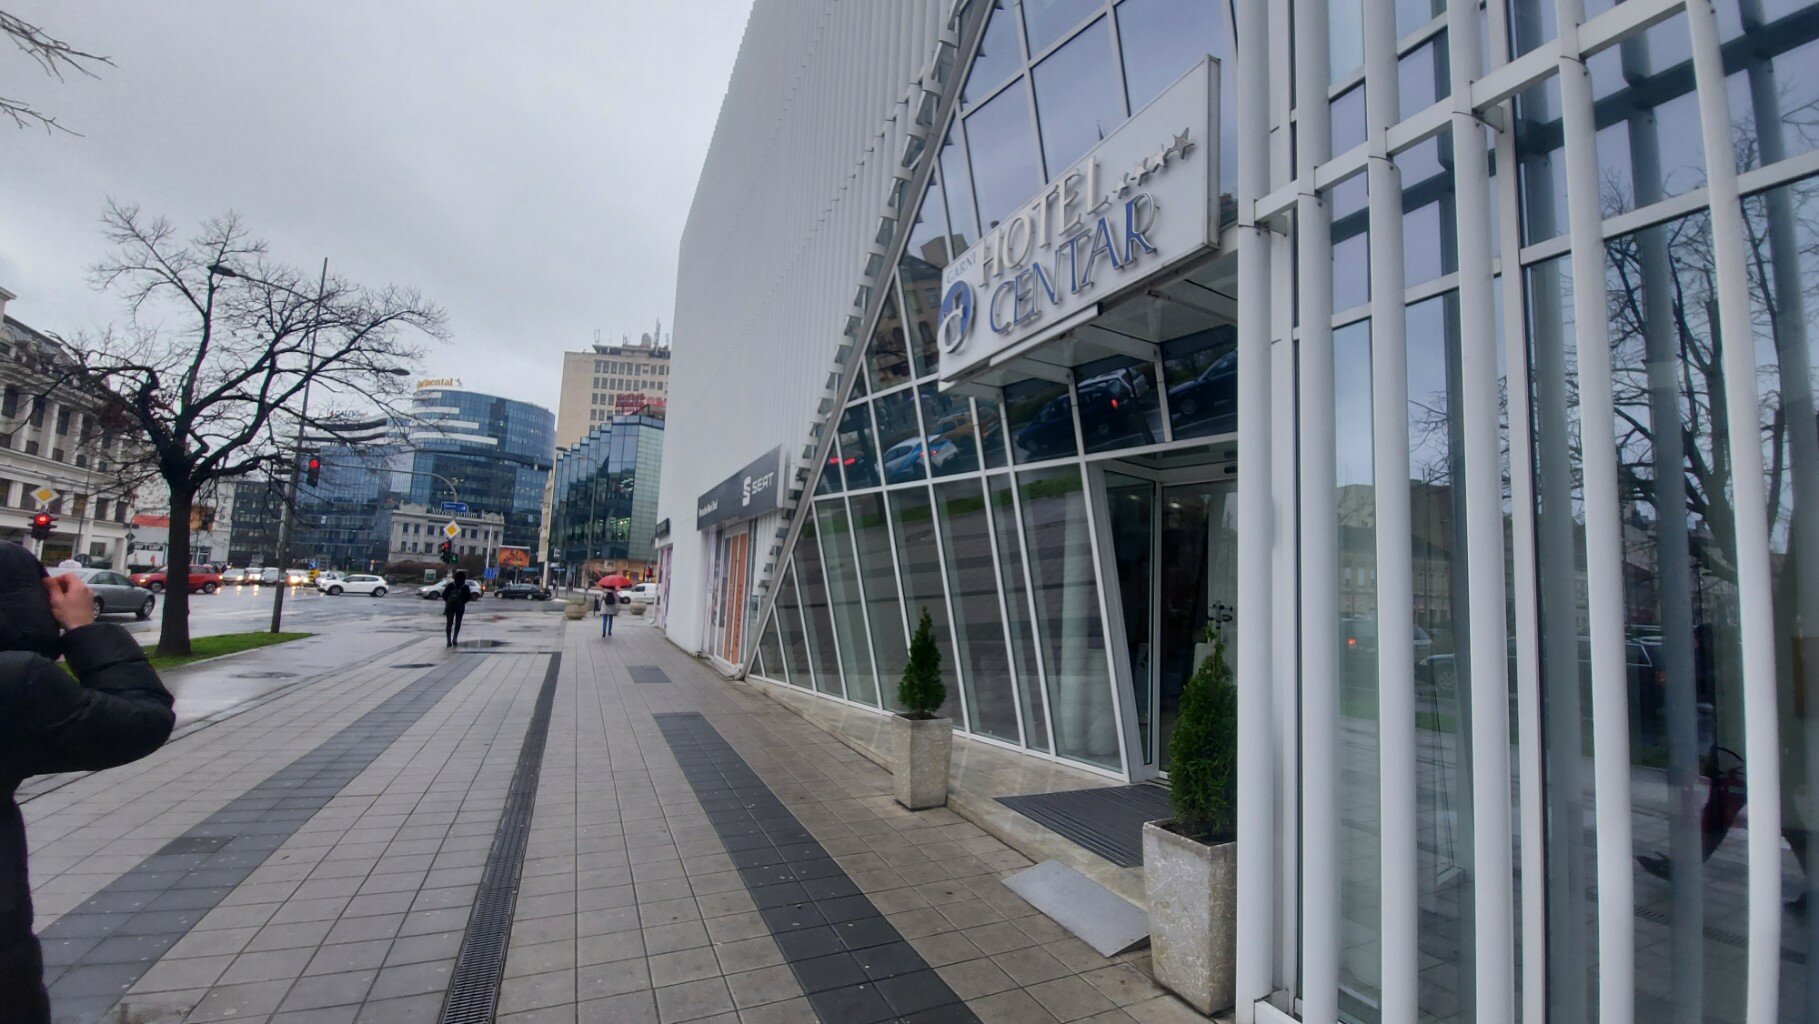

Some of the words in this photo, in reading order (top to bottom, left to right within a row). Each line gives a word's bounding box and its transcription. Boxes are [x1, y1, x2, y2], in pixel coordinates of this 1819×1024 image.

[979, 156, 1111, 287] HOTEL
[990, 192, 1159, 335] CENTAR
[752, 471, 774, 494] SEAT
